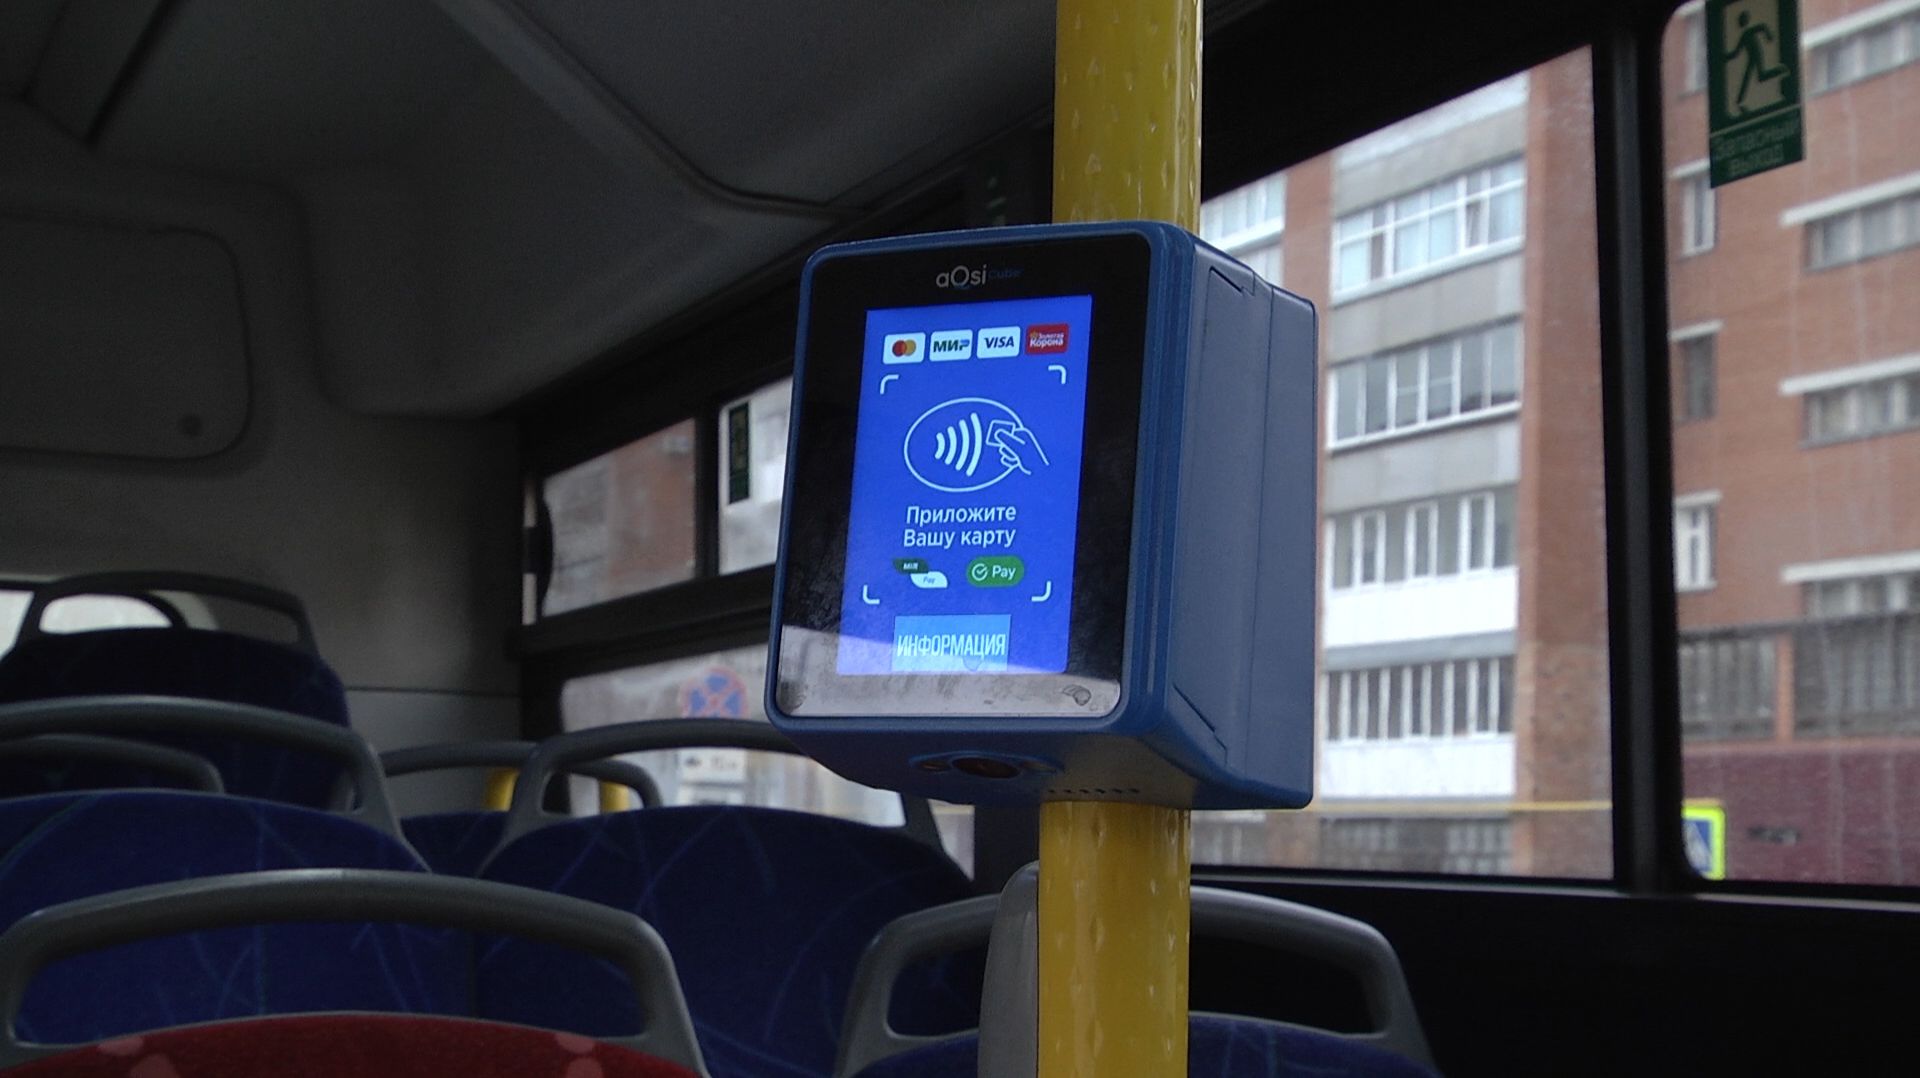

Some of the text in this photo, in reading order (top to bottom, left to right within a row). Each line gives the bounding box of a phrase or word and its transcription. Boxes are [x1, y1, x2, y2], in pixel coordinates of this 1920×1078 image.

[933, 338, 970, 353] МИР
[984, 335, 1015, 349] VISA
[1029, 336, 1064, 348] Корона
[906, 506, 1017, 527] Приложите
[903, 529, 1016, 549] Вашу карту
[992, 565, 1016, 580] Pay
[897, 634, 1006, 658] ИНФОРМАЦИЯ
